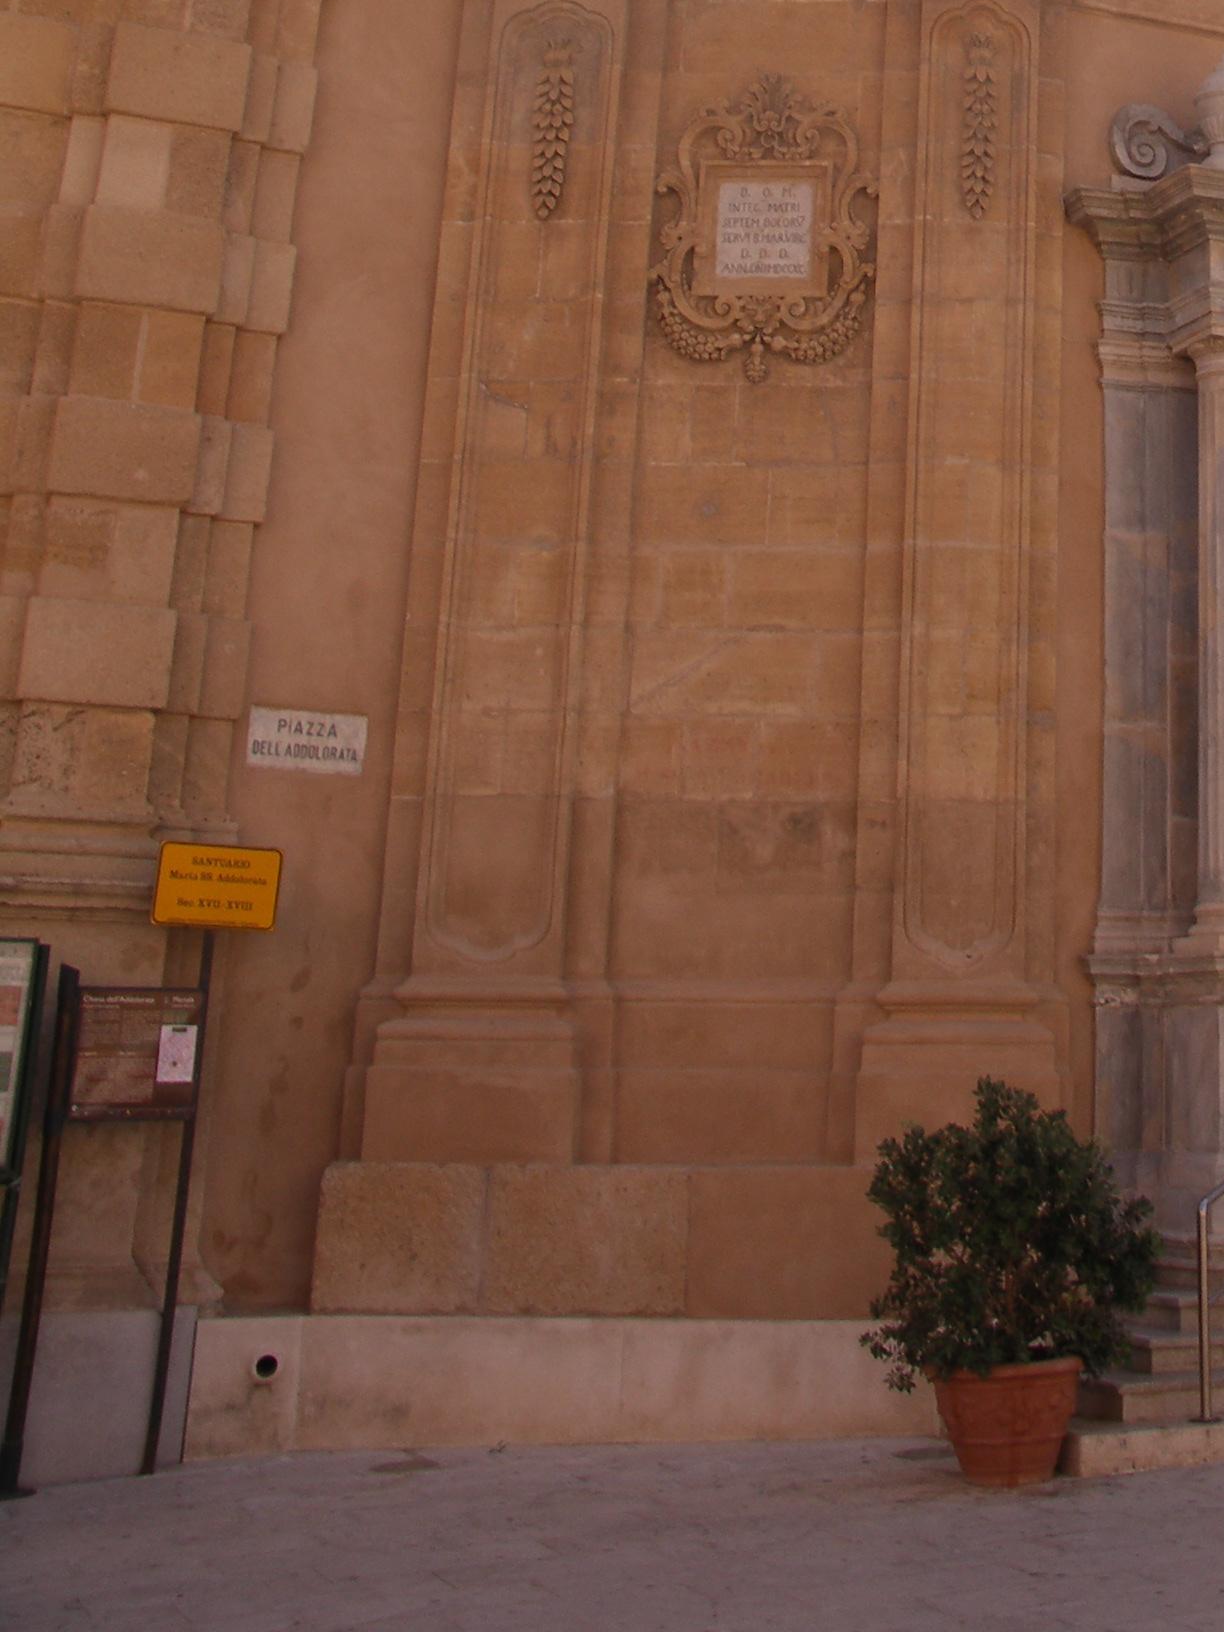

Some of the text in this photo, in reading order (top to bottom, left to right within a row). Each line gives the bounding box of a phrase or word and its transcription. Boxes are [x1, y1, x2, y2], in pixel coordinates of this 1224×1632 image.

[276, 718, 338, 738] PIAZZA
[192, 855, 251, 869] SANTUARIO
[169, 869, 198, 880] Maria
[217, 873, 267, 886] Addolorata
